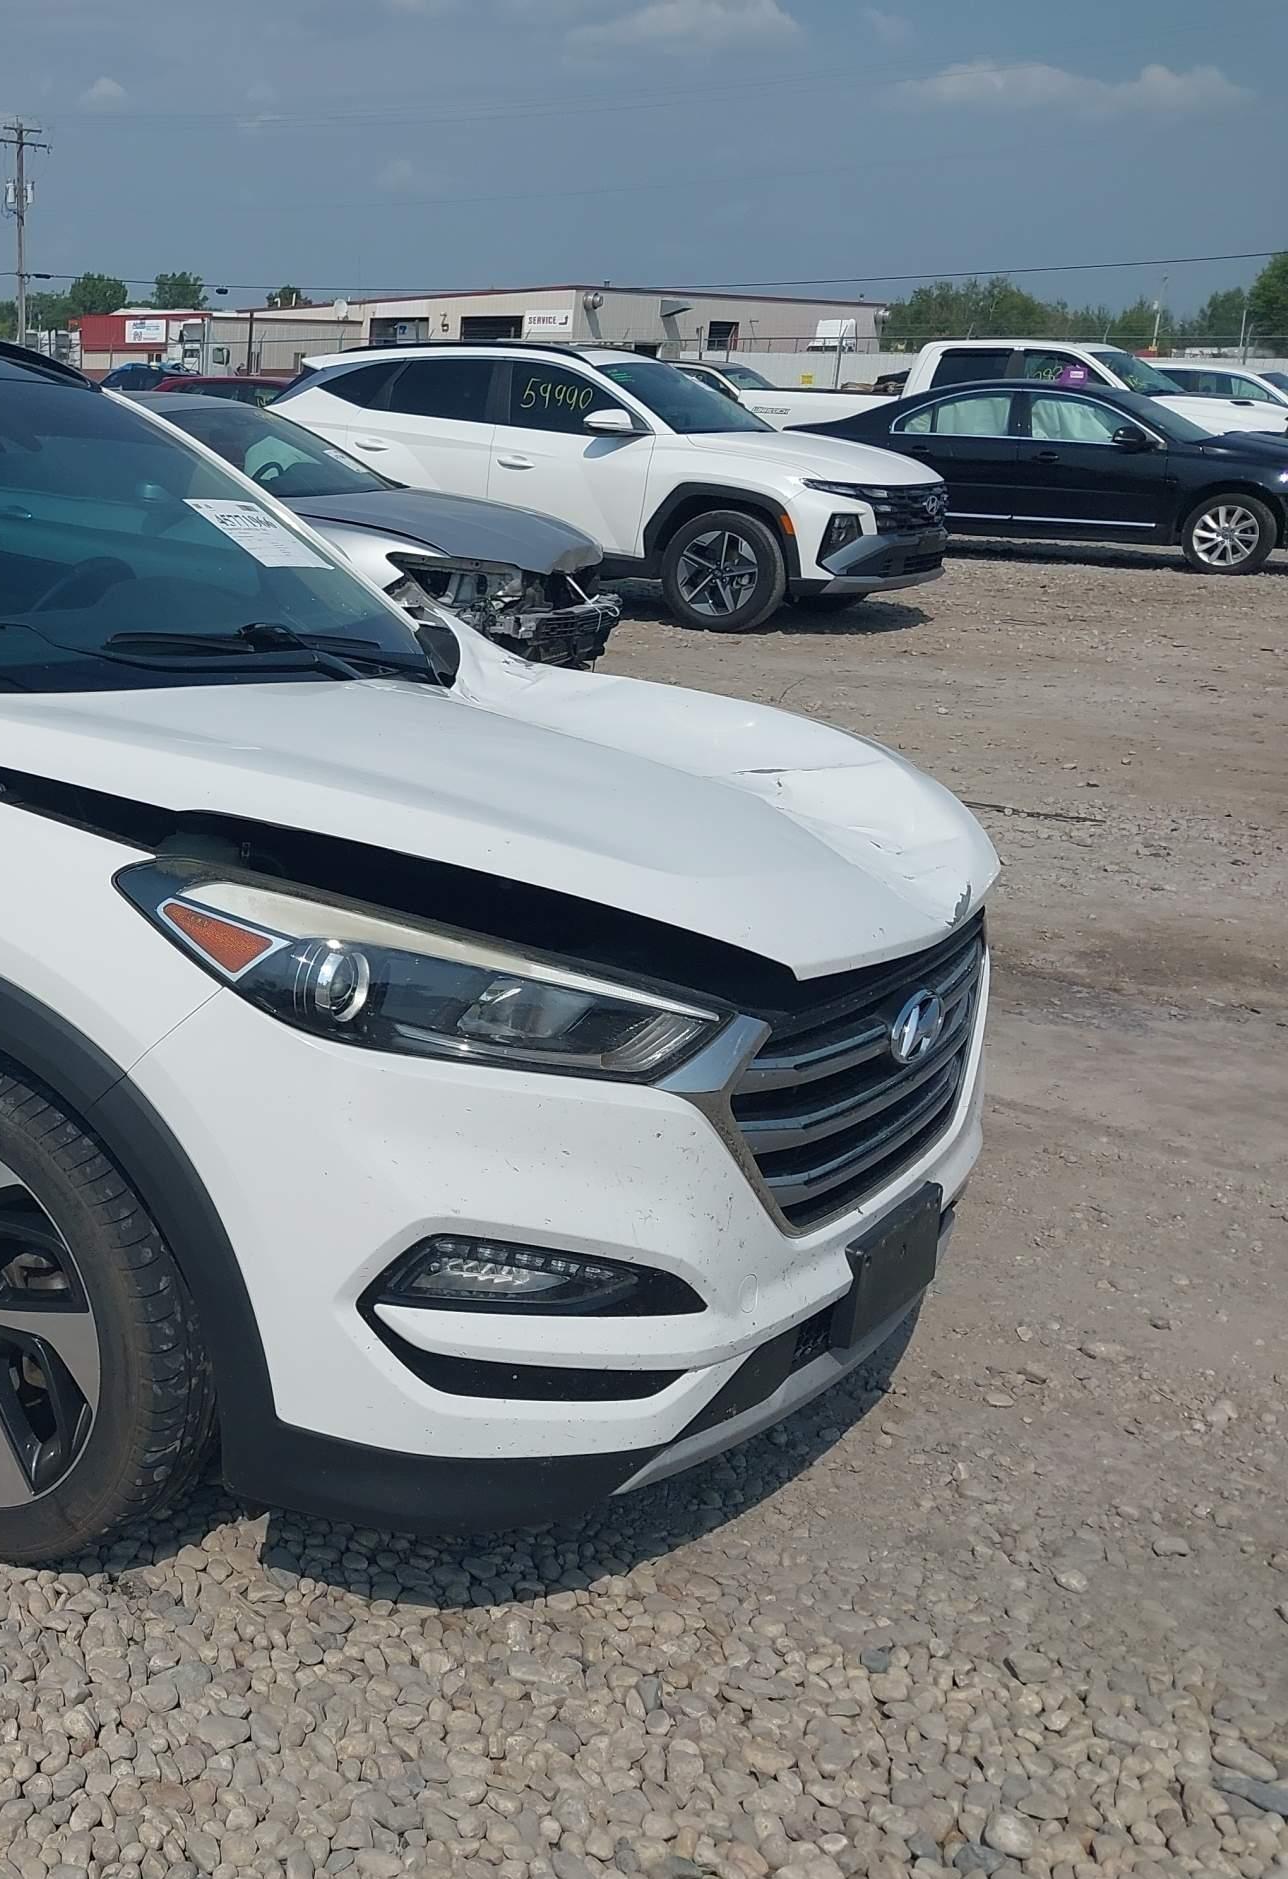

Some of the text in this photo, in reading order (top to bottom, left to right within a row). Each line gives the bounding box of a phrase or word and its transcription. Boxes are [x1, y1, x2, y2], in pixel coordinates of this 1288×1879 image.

[527, 316, 557, 325] SERVICE
[519, 377, 593, 410] 59990
[214, 513, 279, 529] 45771966
